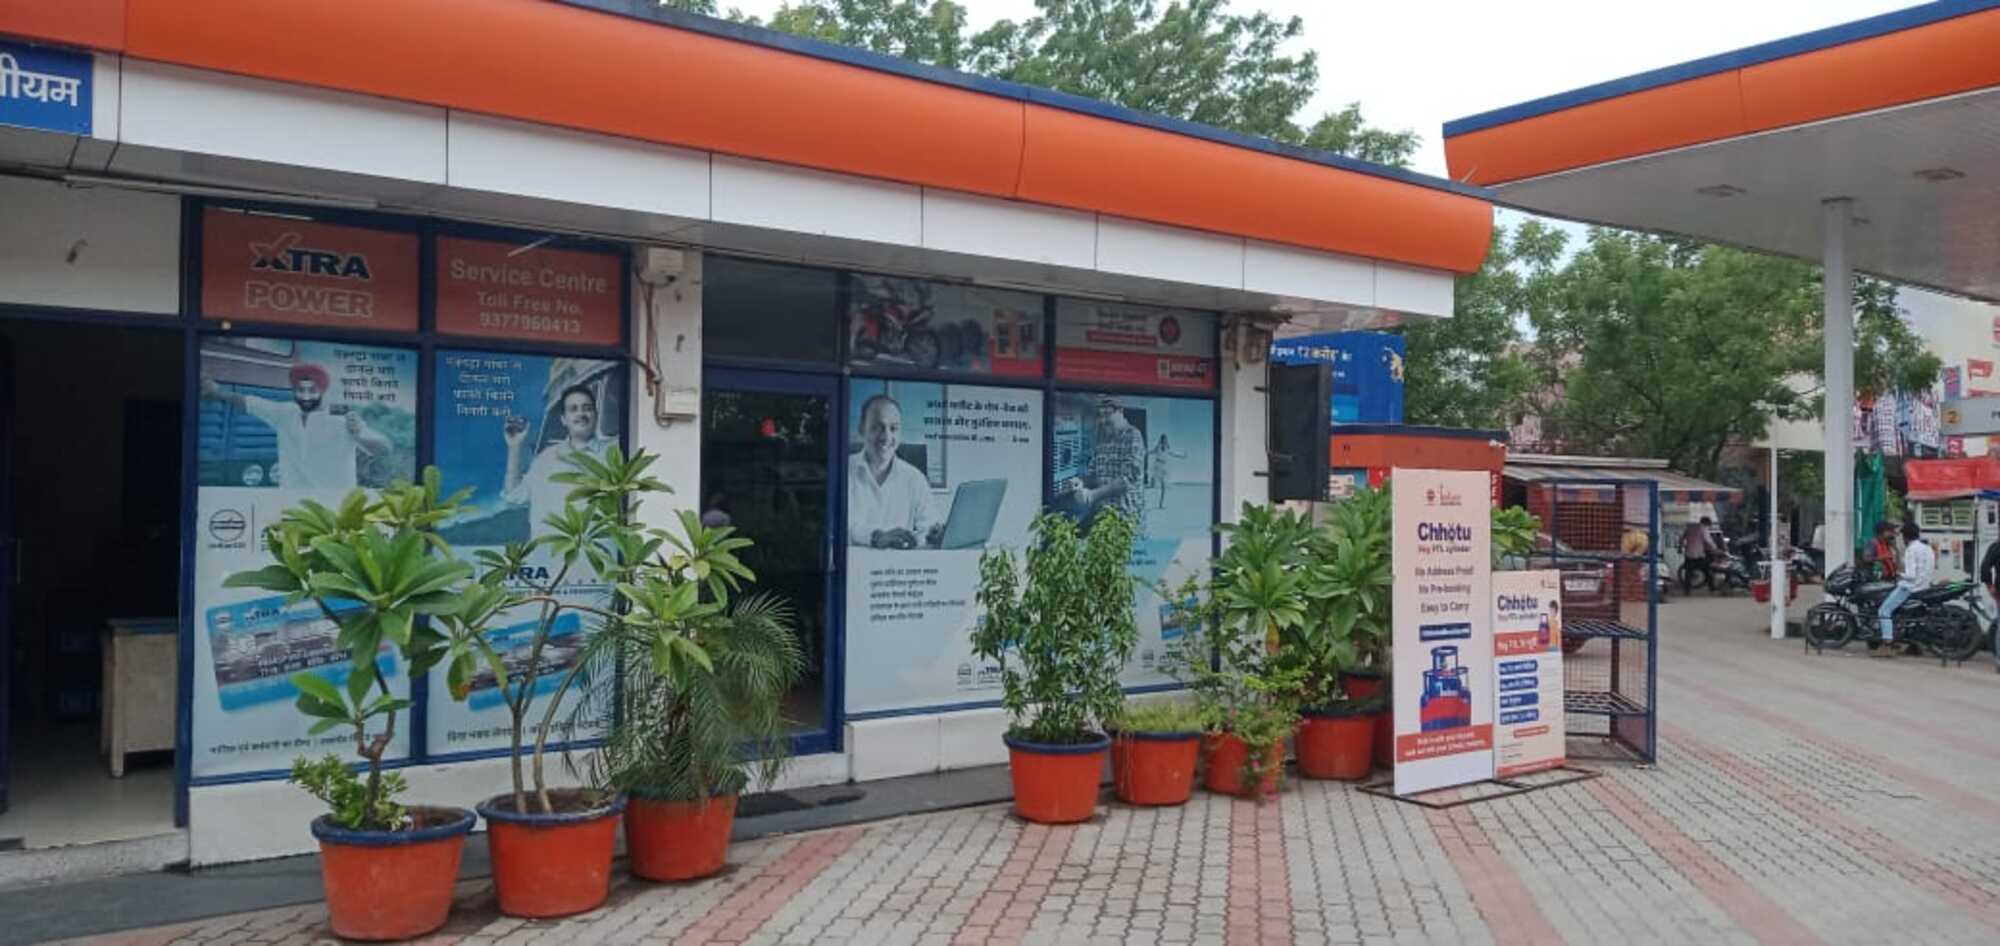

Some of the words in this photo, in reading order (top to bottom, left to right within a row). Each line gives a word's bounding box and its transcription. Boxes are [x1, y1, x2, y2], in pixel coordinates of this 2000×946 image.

[250, 233, 371, 280] XTRA
[450, 258, 532, 286] Service
[538, 267, 608, 294] Centre
[245, 281, 373, 318] POWER
[477, 291, 507, 307] Toll
[513, 295, 551, 312] Free
[1417, 520, 1472, 543] Chhotu
[1427, 566, 1455, 577] Address
[1420, 603, 1439, 616] Easy
